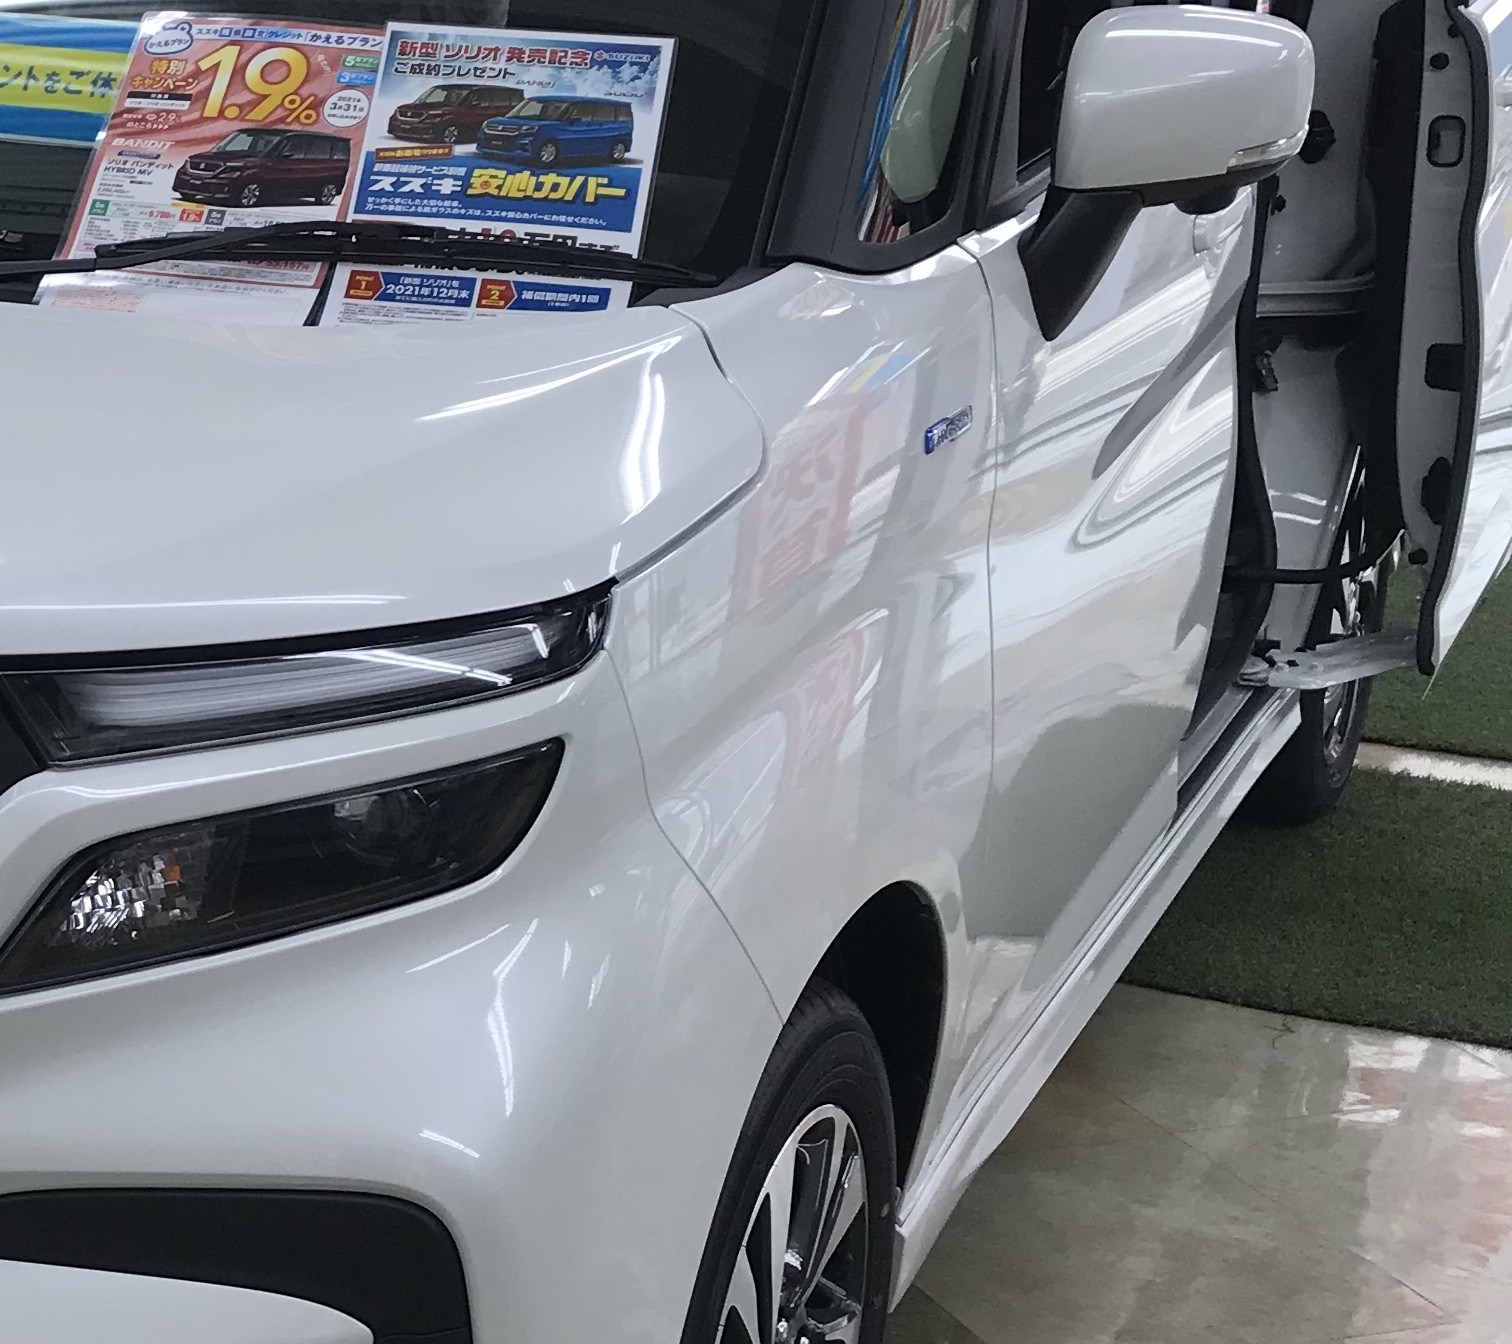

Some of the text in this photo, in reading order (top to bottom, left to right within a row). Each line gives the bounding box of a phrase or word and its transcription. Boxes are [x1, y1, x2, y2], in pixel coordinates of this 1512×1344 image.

[397, 40, 592, 68] 新型 ソリオ 発売記念
[150, 59, 188, 76] 特別
[393, 62, 517, 80] ご成約プレゼント
[131, 76, 198, 92] キャンペーン
[197, 44, 318, 125] 1.9%
[367, 168, 627, 203] スズキ 安心カバー
[360, 281, 366, 290] 1
[385, 284, 471, 300] 2021年12月末
[490, 291, 499, 300] 2
